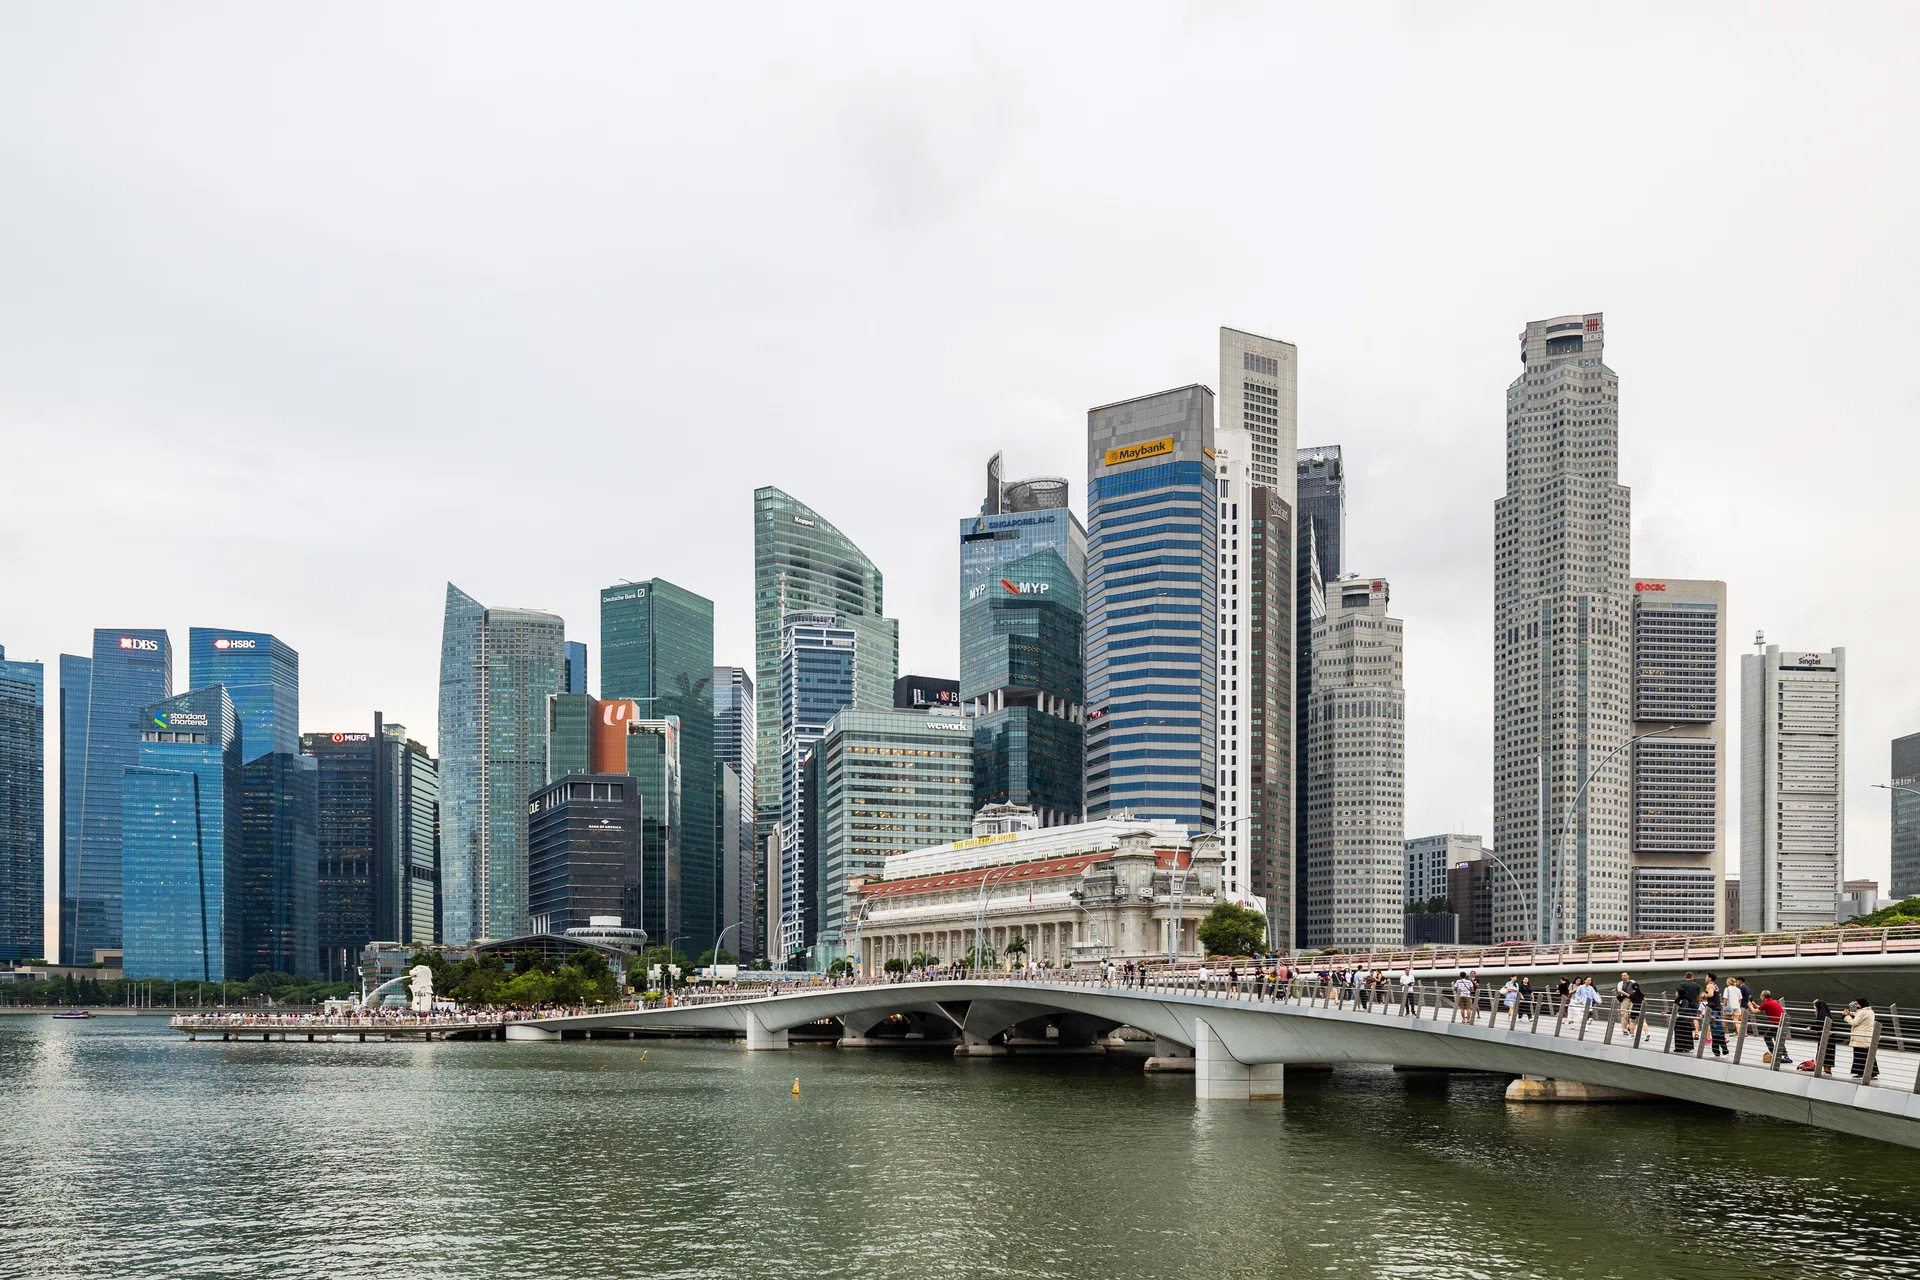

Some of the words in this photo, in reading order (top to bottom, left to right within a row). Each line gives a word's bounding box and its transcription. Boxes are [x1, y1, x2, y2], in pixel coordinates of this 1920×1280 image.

[1583, 332, 1603, 342] UOB
[1119, 441, 1166, 458] Maybank
[988, 516, 1055, 529] SINGAPORELAND
[969, 583, 986, 600] MYP
[1019, 582, 1049, 594] MYP
[603, 595, 624, 603] Deutsche
[1369, 592, 1386, 600] UOB
[132, 639, 158, 651] DBS
[230, 640, 256, 649] HSBC
[1798, 656, 1821, 667] Singtel
[170, 712, 206, 720] standard
[170, 718, 208, 726] chartered
[926, 720, 968, 731] wework
[344, 734, 367, 742] MUFG
[952, 841, 963, 850] THE
[964, 836, 996, 848] FULLERTON
[997, 833, 1017, 843] HOTEL
